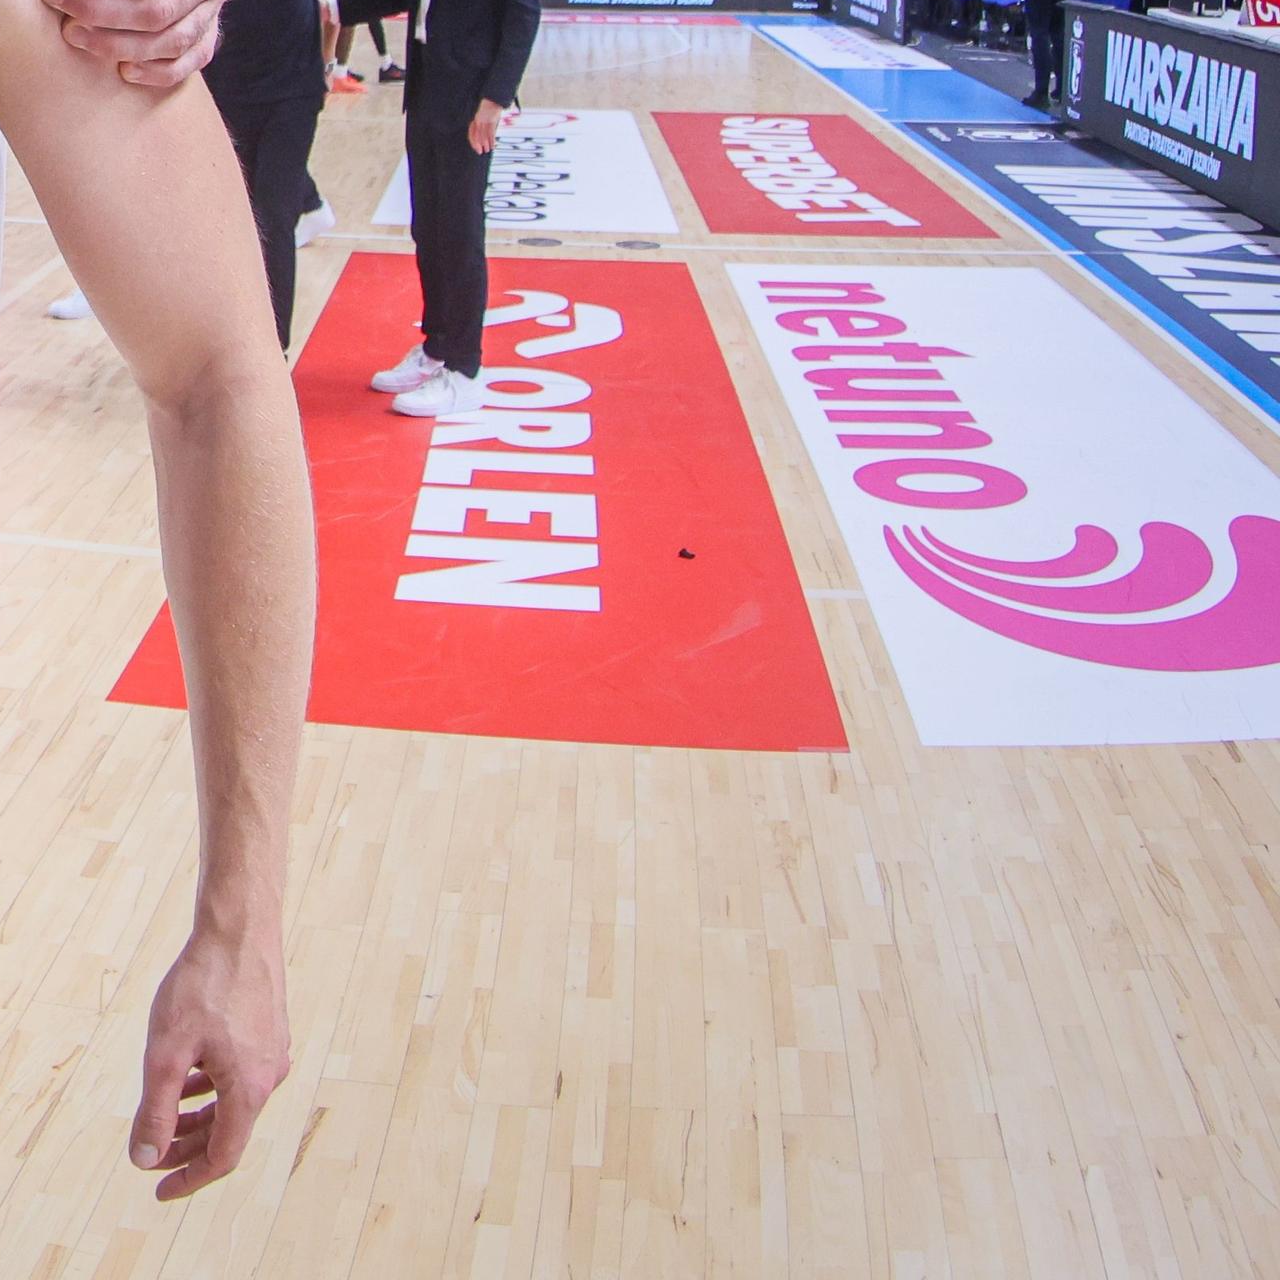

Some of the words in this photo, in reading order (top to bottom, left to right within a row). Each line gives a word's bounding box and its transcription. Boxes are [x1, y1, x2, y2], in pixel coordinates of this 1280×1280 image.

[719, 115, 923, 228] SUPERBET
[1104, 30, 1257, 161] WARSZAWA
[758, 280, 1028, 509] netuno
[394, 366, 601, 612] ORLEN
